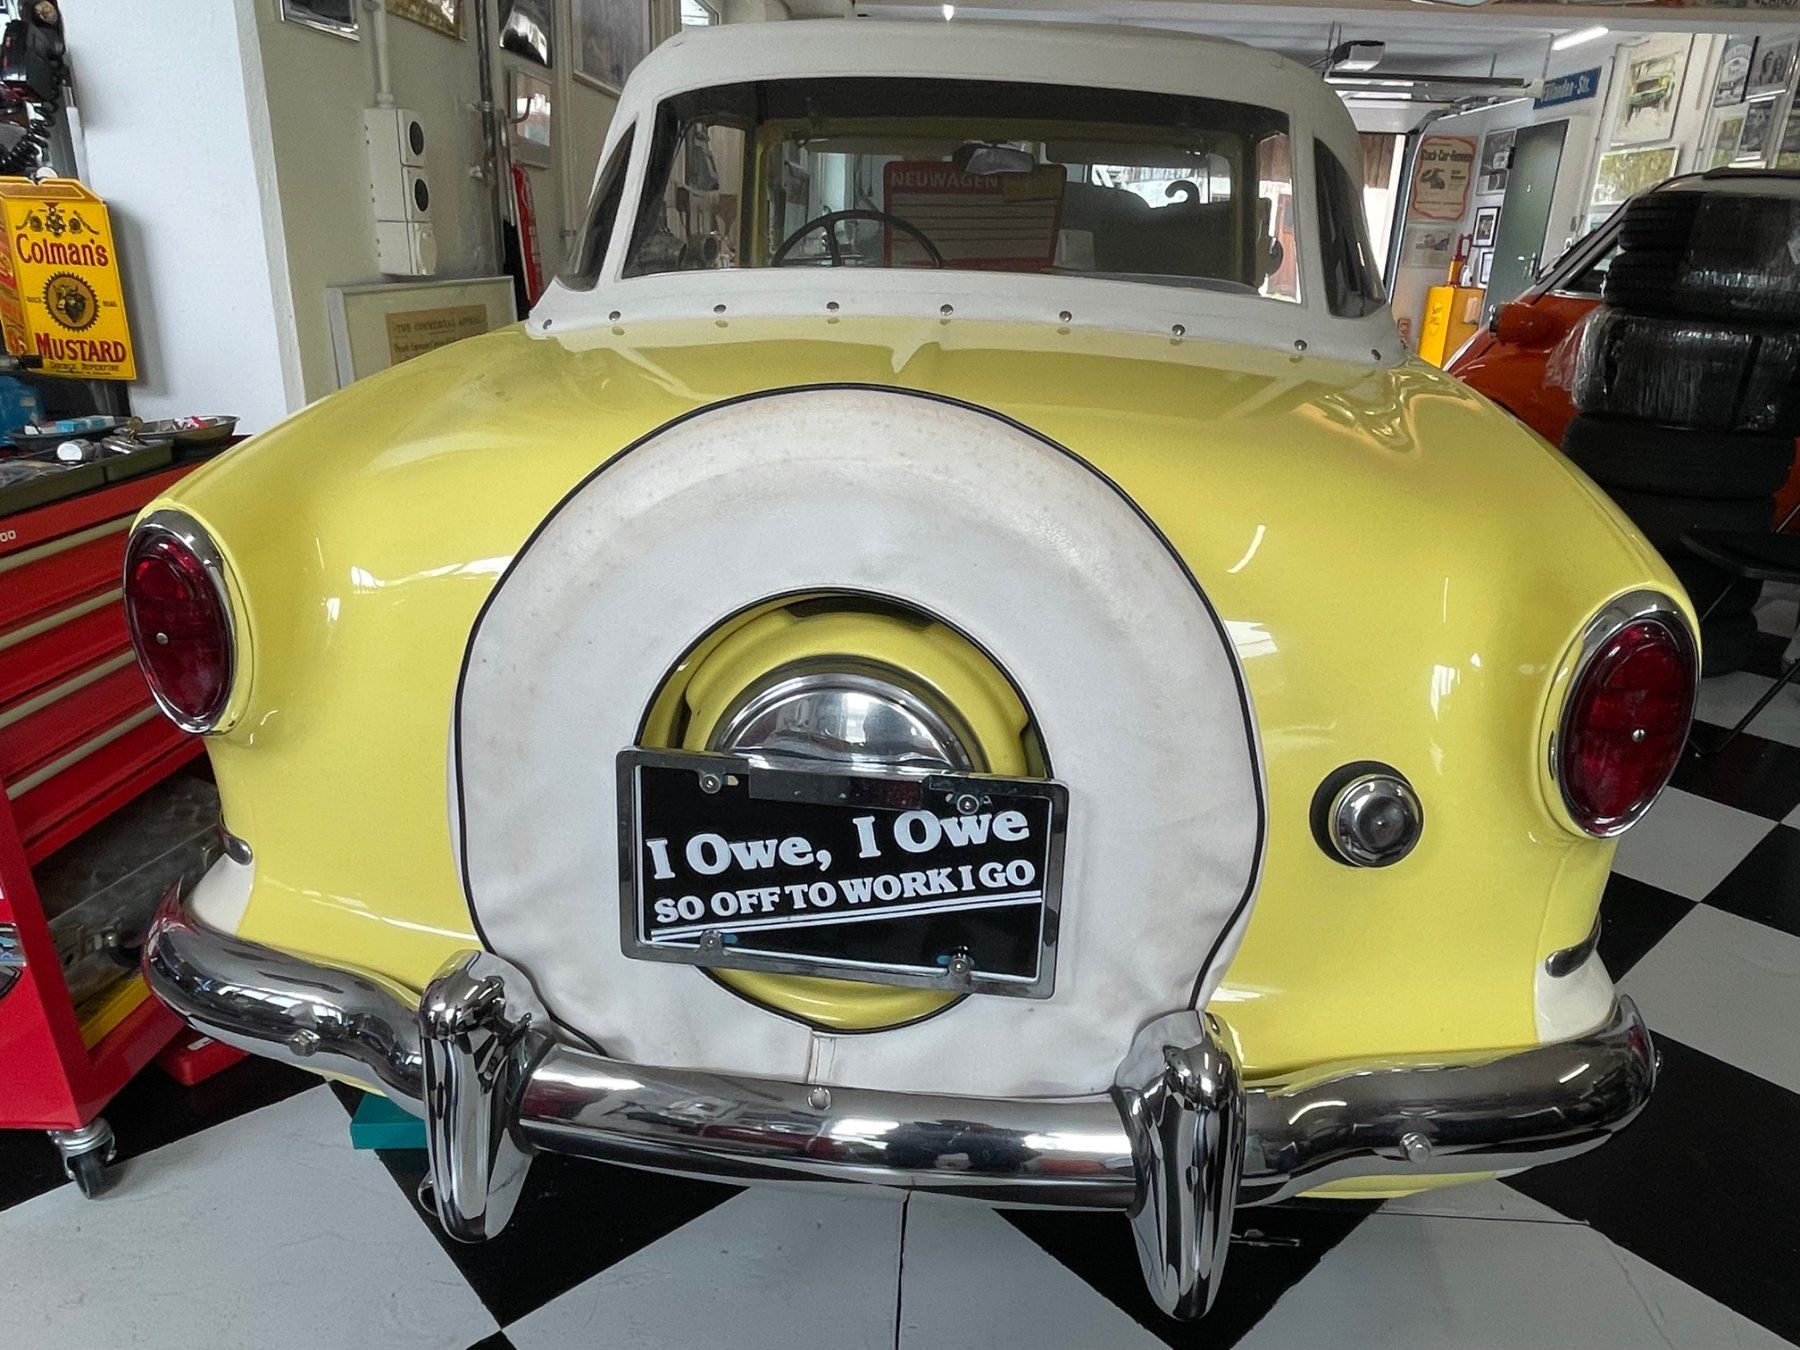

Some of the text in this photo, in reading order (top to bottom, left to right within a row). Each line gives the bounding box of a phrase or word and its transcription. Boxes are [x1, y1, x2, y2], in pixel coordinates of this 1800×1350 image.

[891, 172, 997, 188] NEUWAGEN
[16, 233, 109, 267] Colman's
[35, 332, 127, 363] MUSTARD
[647, 810, 1030, 880] I Owe, I Owe
[654, 859, 1036, 923] SO OFF TO WORK I GO
